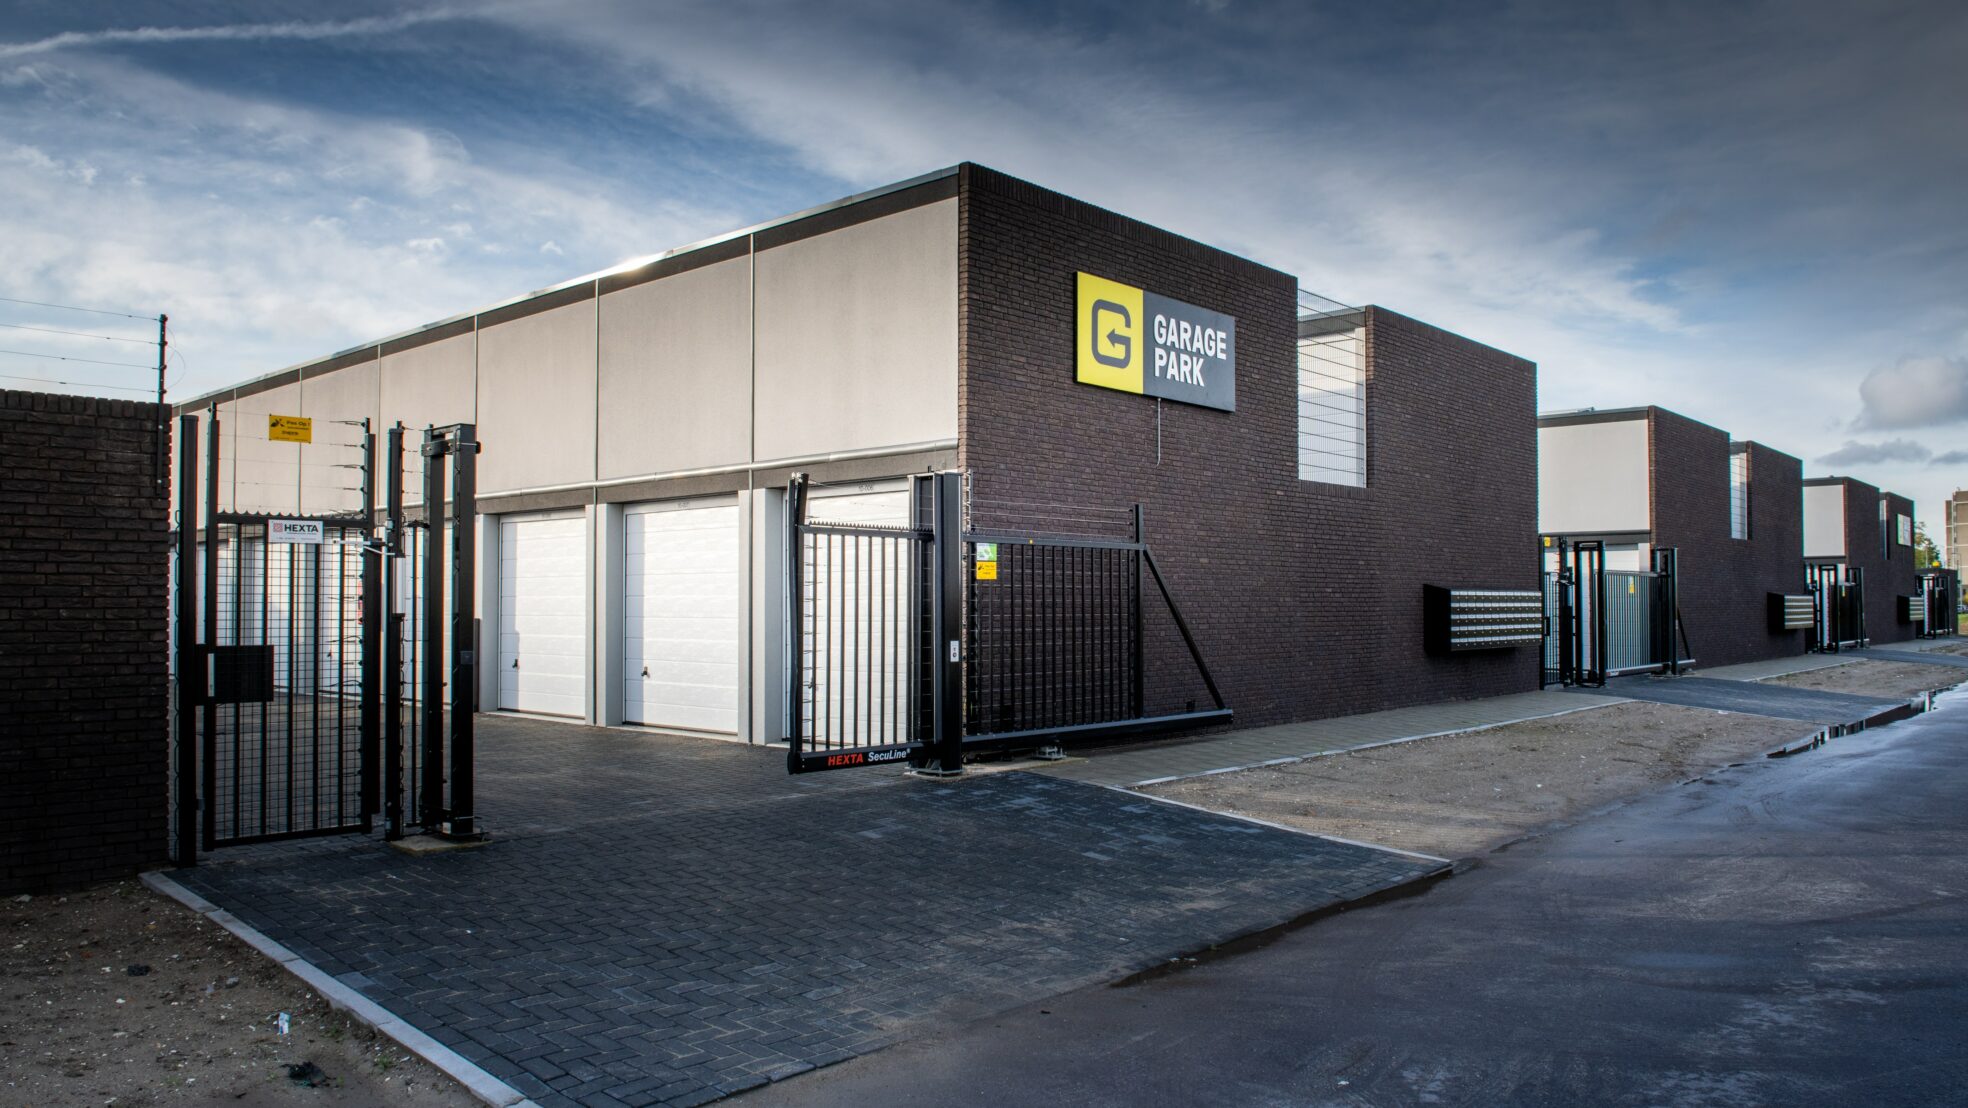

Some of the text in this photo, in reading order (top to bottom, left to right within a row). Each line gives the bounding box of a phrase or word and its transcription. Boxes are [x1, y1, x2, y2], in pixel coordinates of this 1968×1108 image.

[1153, 314, 1227, 360] GARAGE
[1154, 347, 1205, 387] PARK
[284, 523, 319, 533] HEXTA
[828, 753, 864, 766] HEXTA
